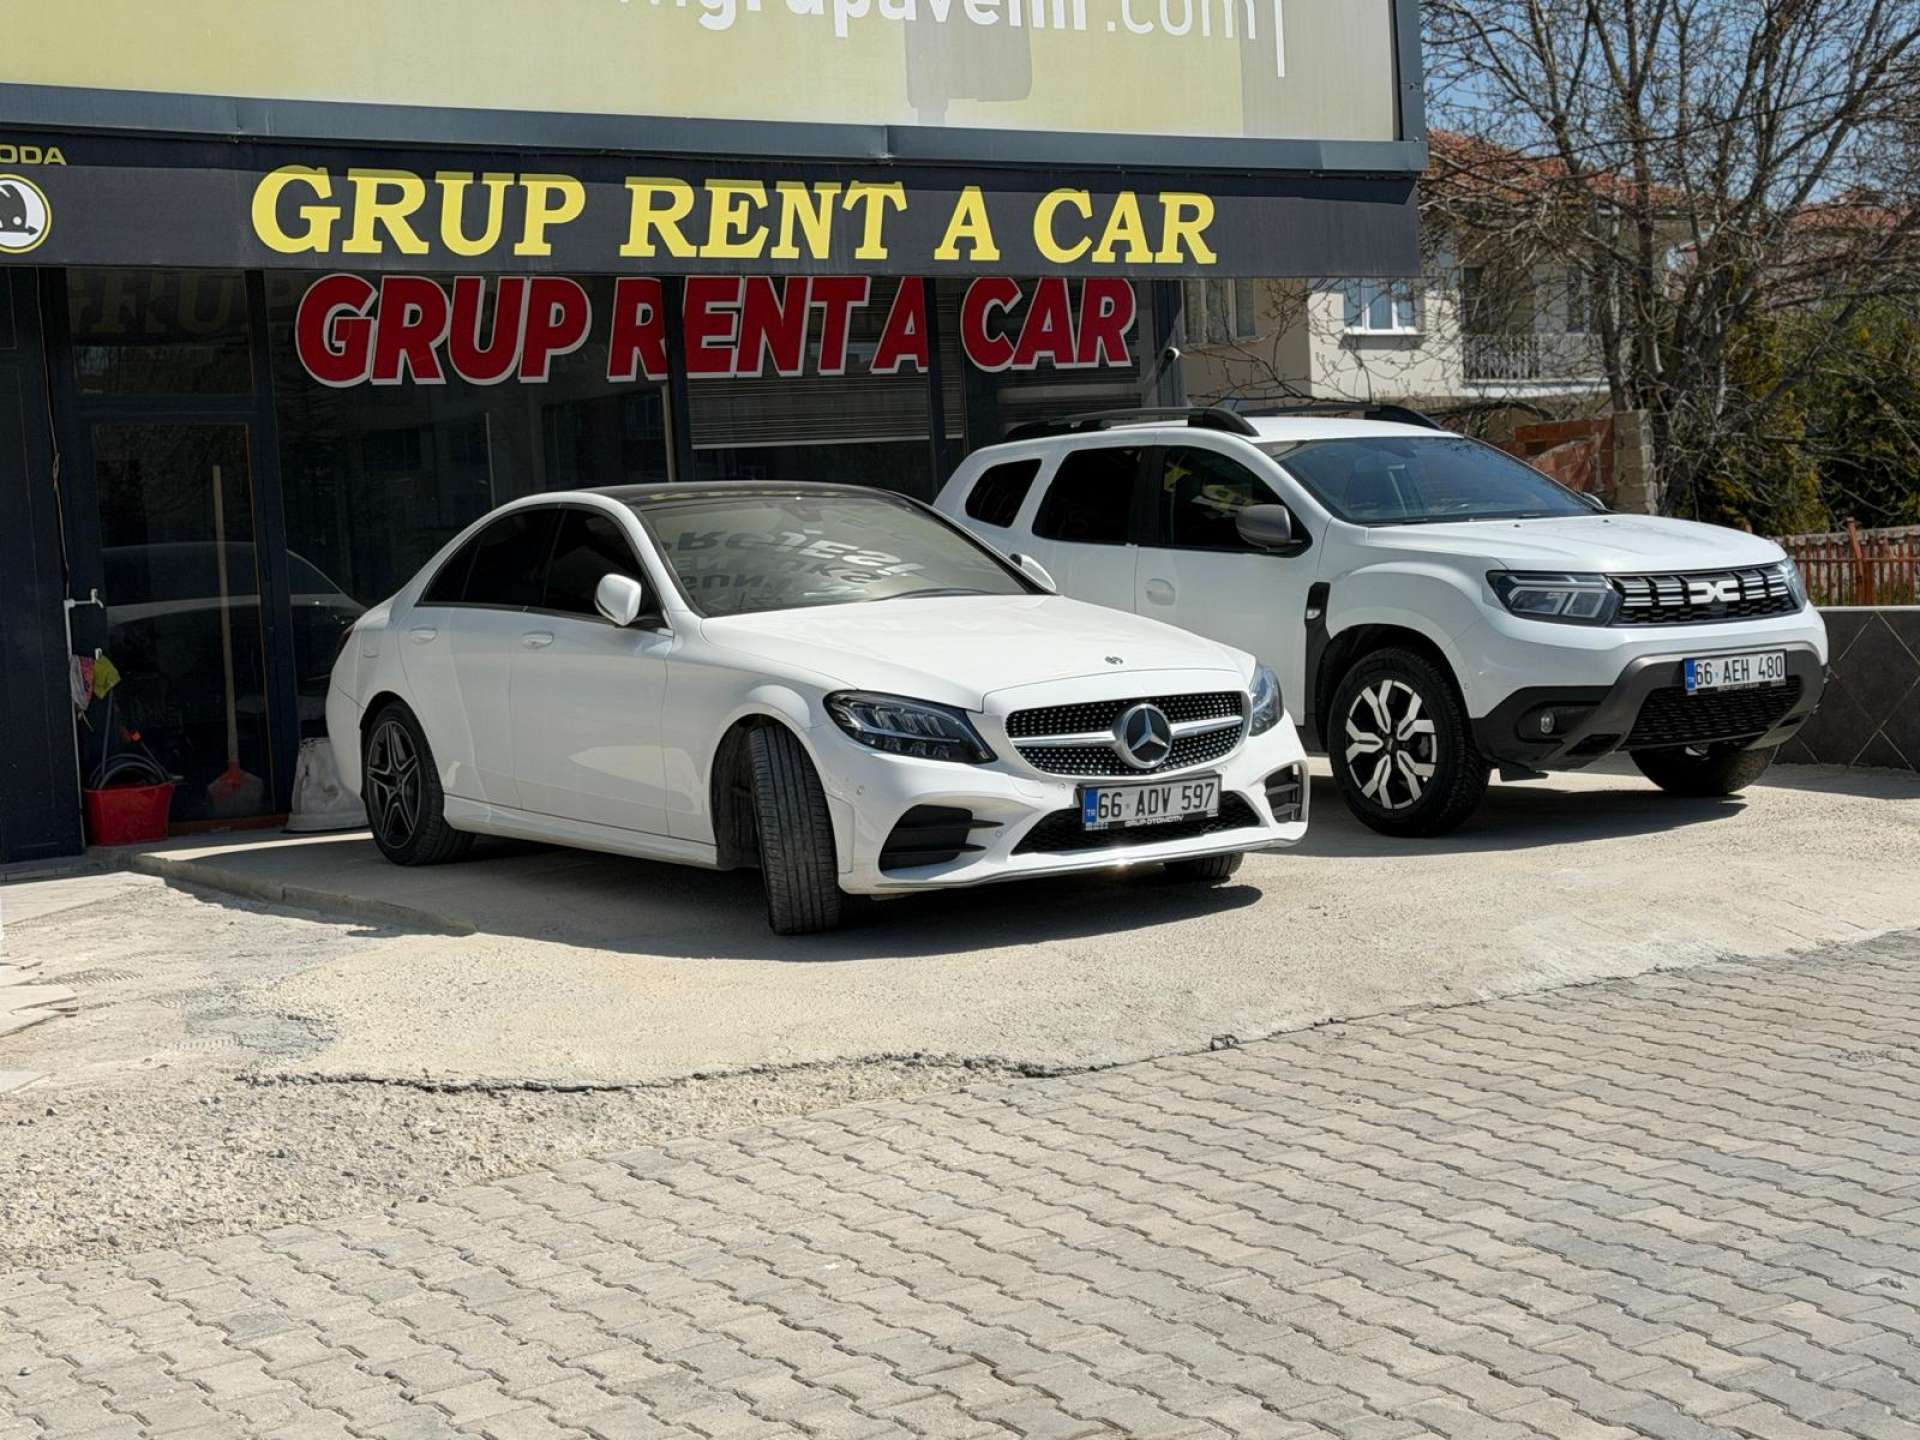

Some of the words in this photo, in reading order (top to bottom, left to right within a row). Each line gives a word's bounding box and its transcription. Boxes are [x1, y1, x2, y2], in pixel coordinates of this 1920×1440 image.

[252, 165, 586, 257] GRUP
[619, 176, 908, 260] RENT
[933, 186, 1000, 263] A
[1033, 187, 1218, 265] CAR
[295, 273, 592, 388] GRUP
[606, 275, 872, 382] RENT
[869, 275, 929, 375] A
[959, 276, 1137, 373] CAR
[1695, 662, 1713, 685] 66
[1723, 658, 1751, 683] AEH
[1758, 655, 1783, 679] 480
[1098, 792, 1122, 818] 66
[1136, 787, 1171, 816] ADV
[1181, 782, 1215, 810] 597
